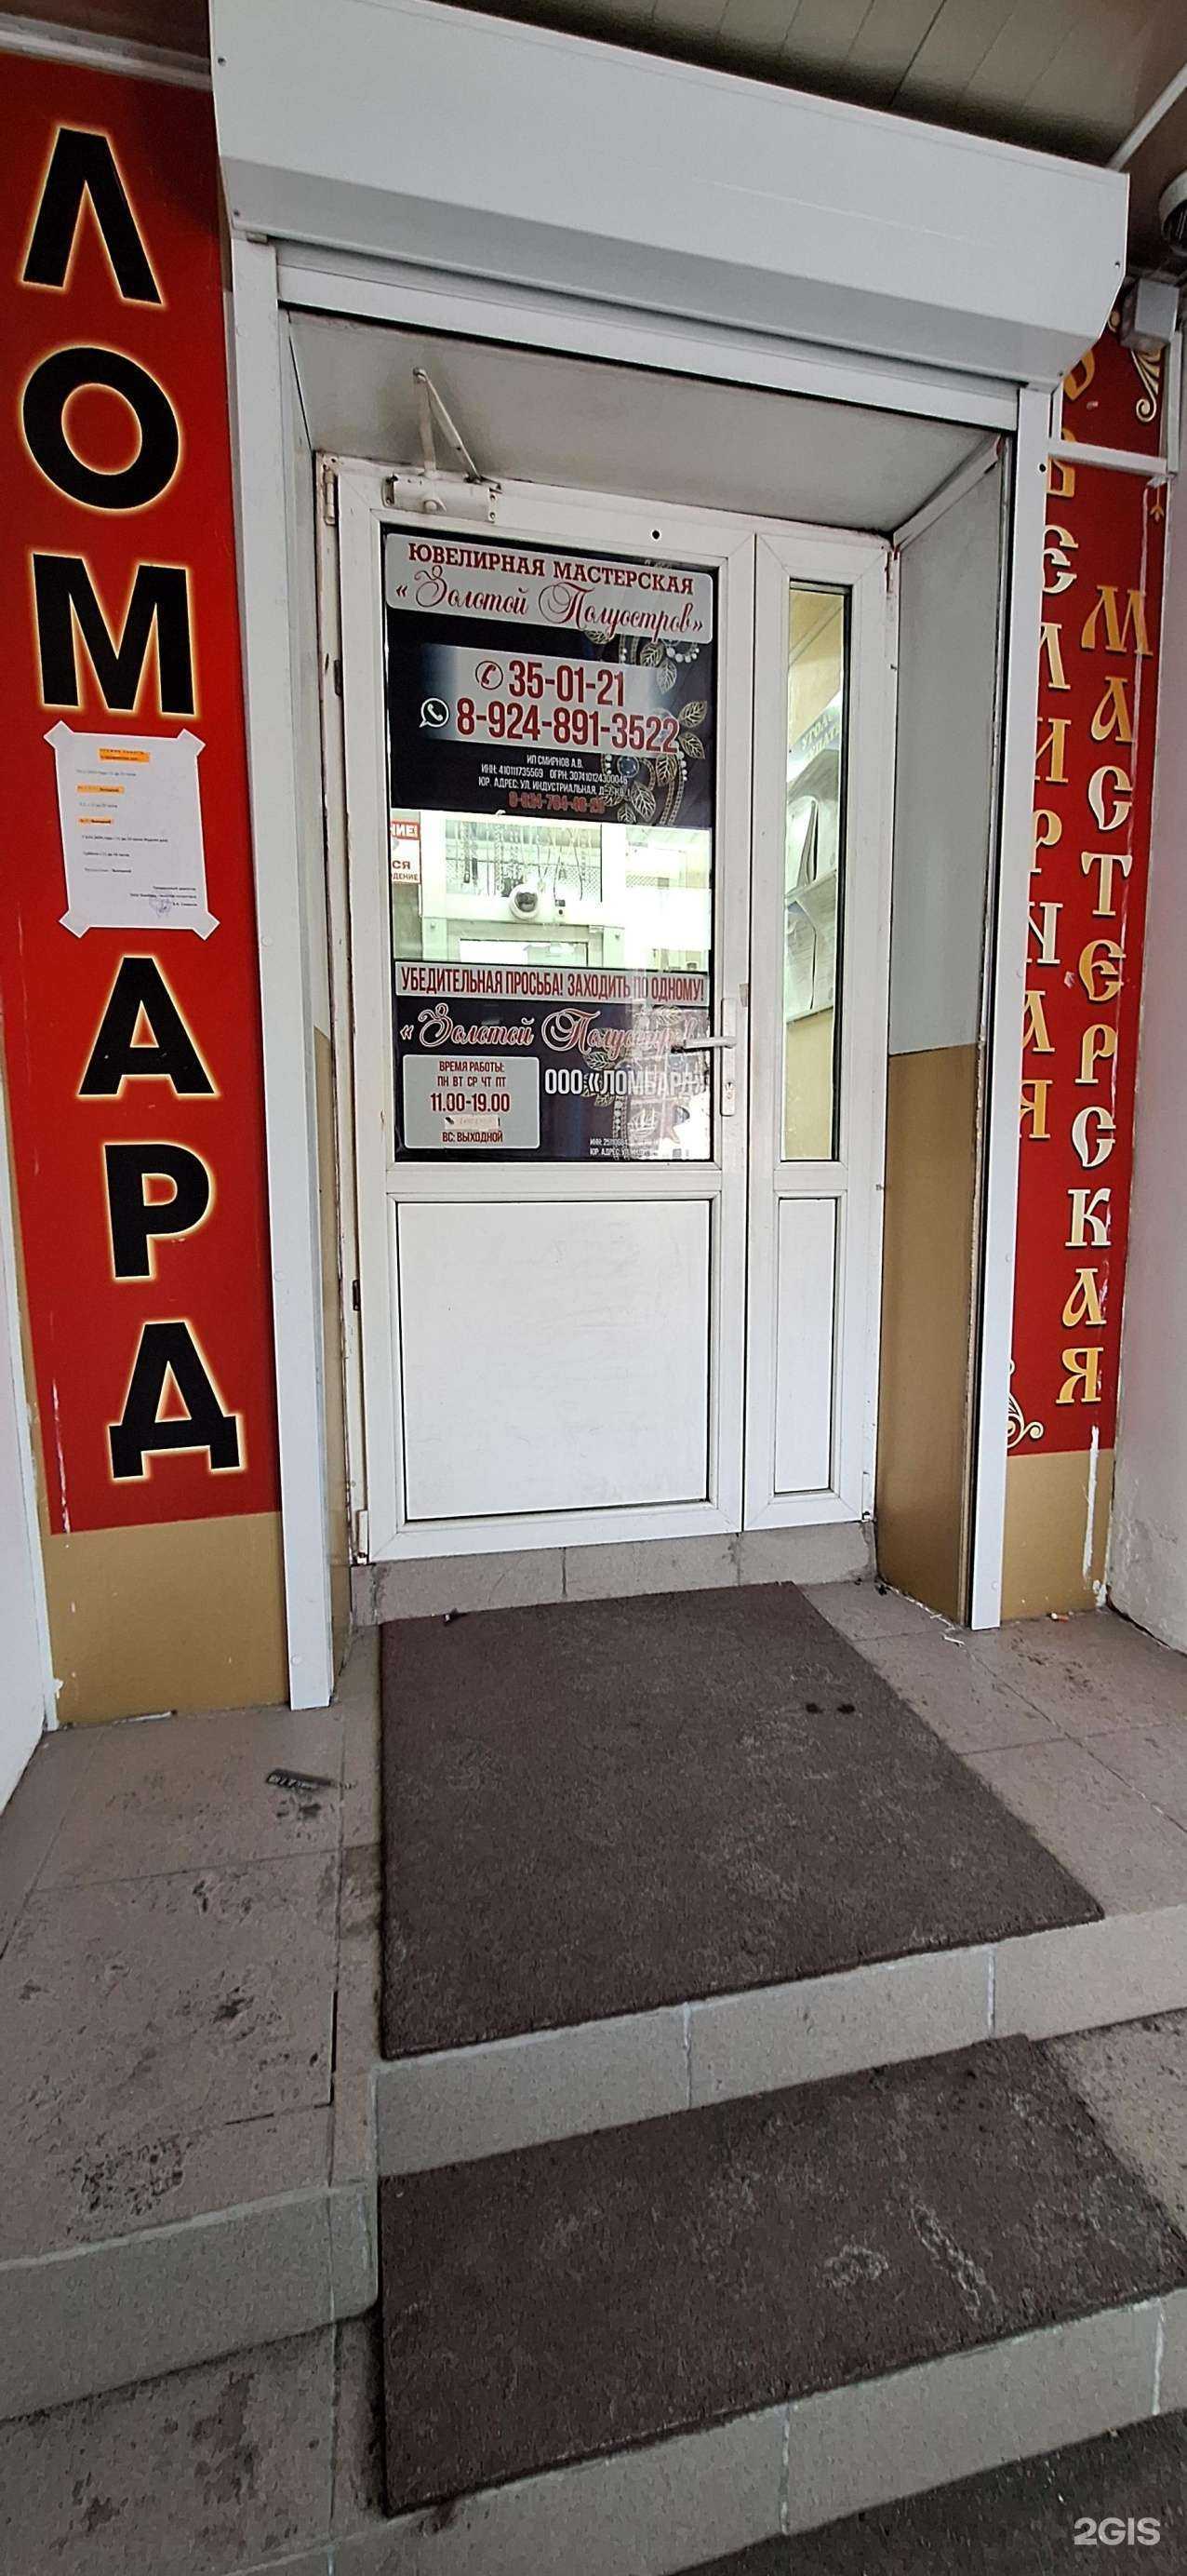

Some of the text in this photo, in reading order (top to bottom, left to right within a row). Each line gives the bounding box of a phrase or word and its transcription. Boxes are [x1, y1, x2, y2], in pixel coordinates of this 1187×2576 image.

[408, 543, 694, 596] ЮВЕЛИРНАЯ МАСТЕРСКАЯ
[509, 660, 625, 708] 35-01-21
[457, 697, 680, 754] 8-924-891-3522
[527, 754, 537, 765] ИП
[20, 126, 244, 1482] ЛОМАРД
[401, 966, 502, 994] УБЕДИТЕЛЬНАЯ
[505, 971, 564, 997] ПРОСЬБА!
[567, 973, 631, 1000] ЗАХОДИТЬ
[651, 977, 704, 1002] ОДНОМУ!
[1054, 584, 1154, 1406] МАСТЕРСКАЯ
[437, 1076, 507, 1088] ПН ВТ СР ЧТ ПТ
[439, 1061, 504, 1073] ВРЕМЯ РАБОТЫ:
[544, 1068, 583, 1095] ООО
[430, 1093, 511, 1112] 11.00-19.00
[442, 1130, 503, 1144] ВС: ВЫХОДНОЙ
